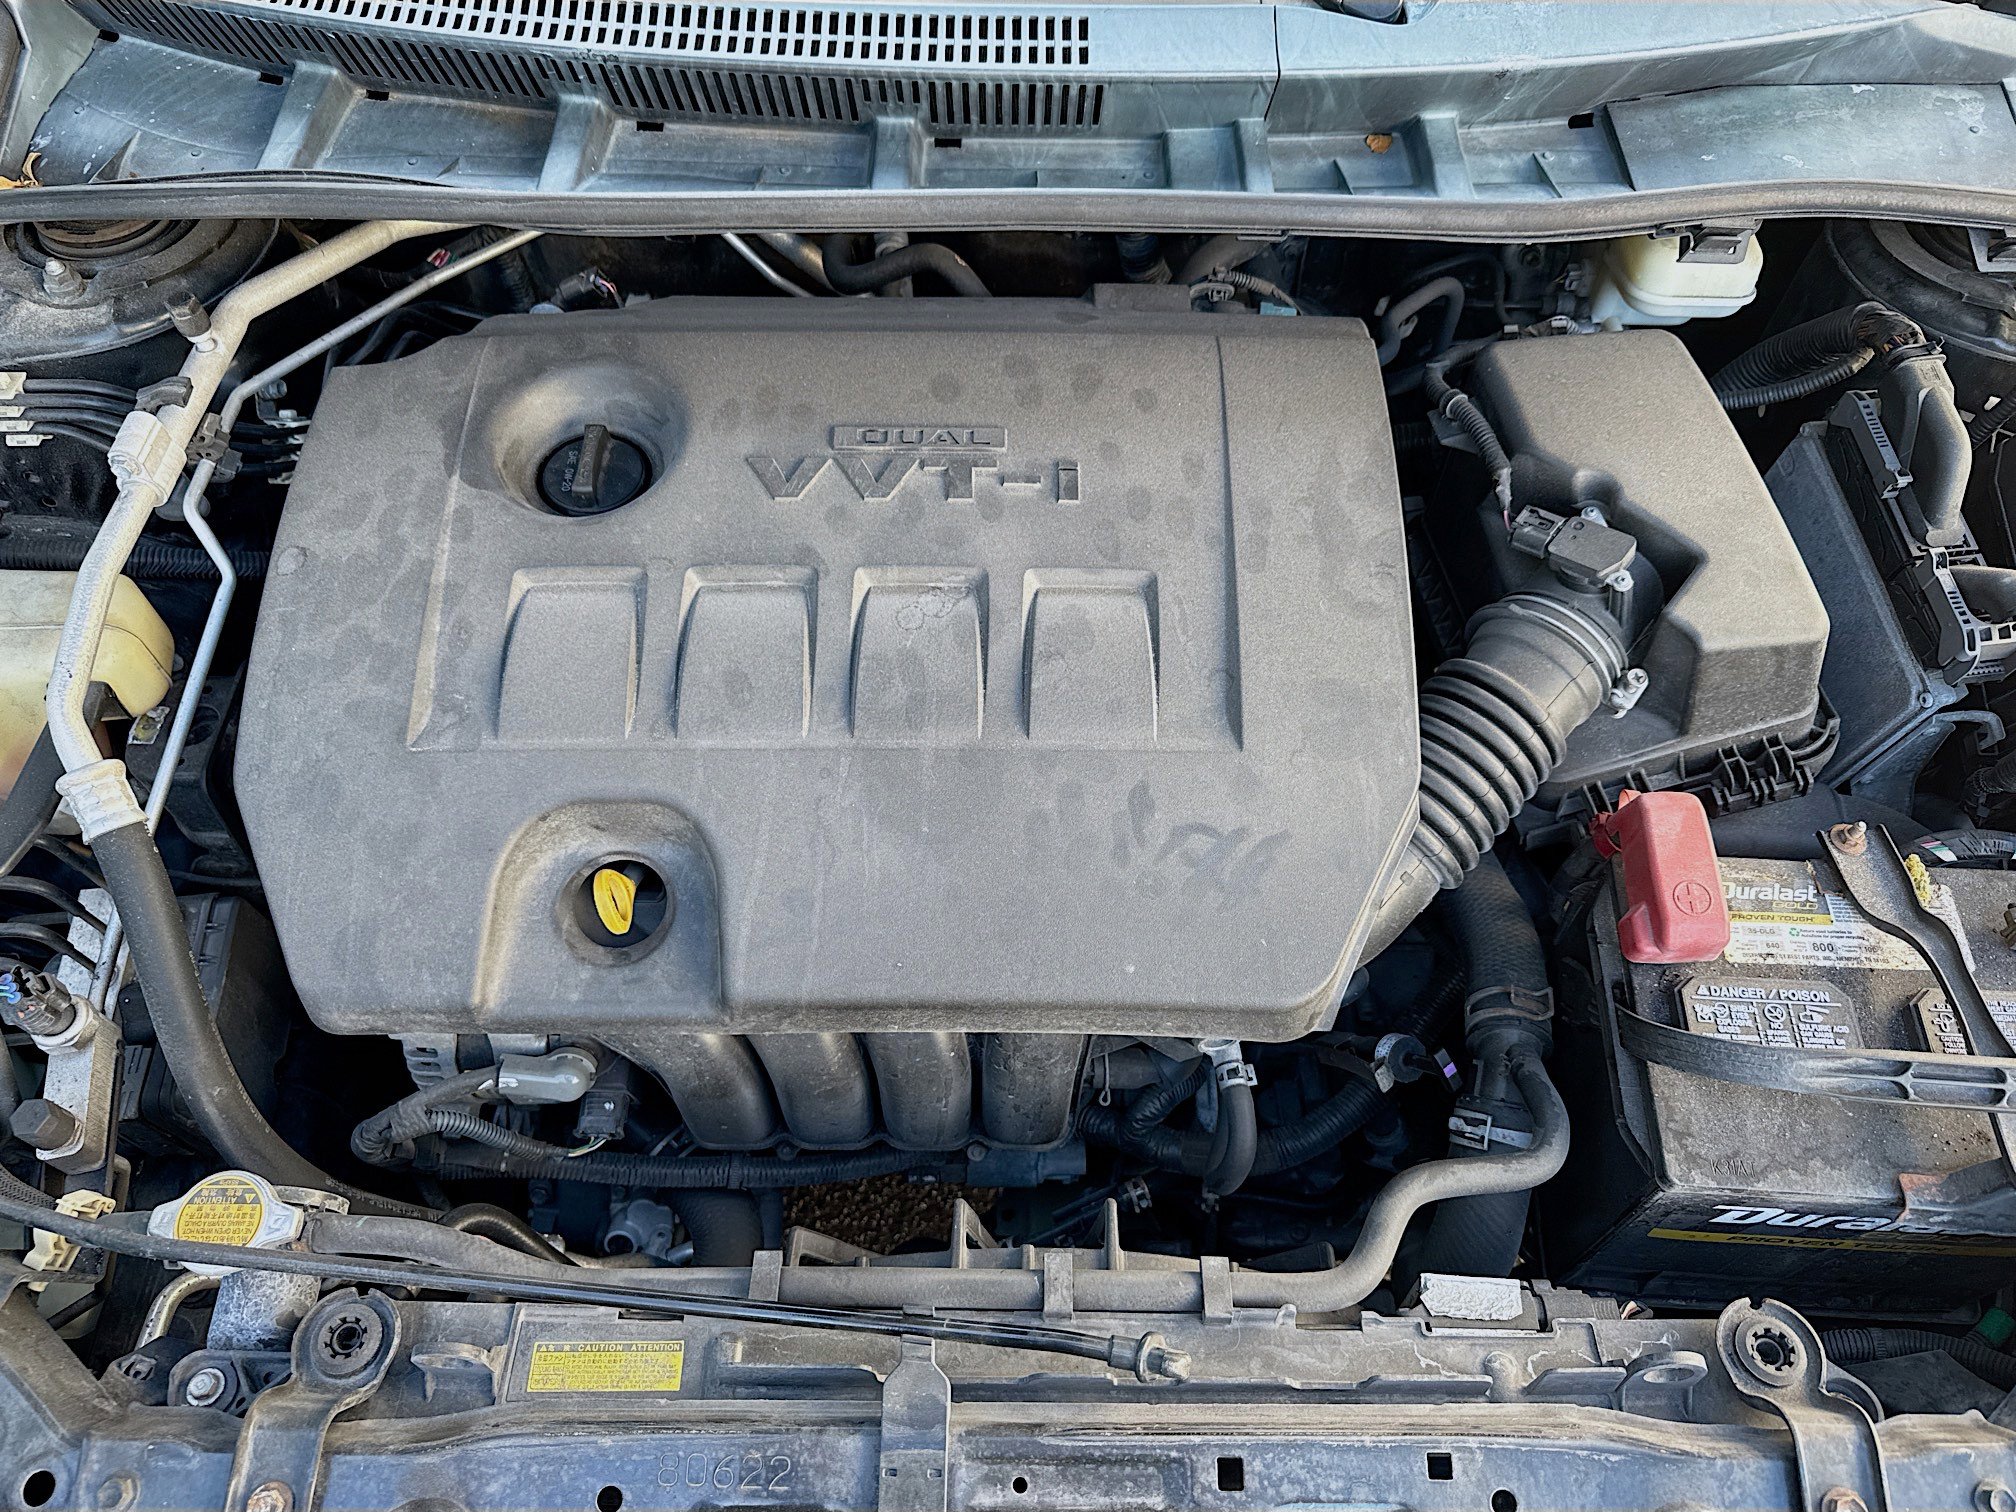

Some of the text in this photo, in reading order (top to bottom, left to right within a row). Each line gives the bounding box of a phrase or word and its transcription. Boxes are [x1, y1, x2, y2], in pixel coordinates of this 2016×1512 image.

[857, 429, 991, 445] DUAL
[561, 450, 578, 492] SAE 0W-20
[1772, 901, 1818, 911] GOLD
[1731, 913, 1814, 922] PROVEN TOUGH
[1812, 942, 1834, 952] 800
[1709, 985, 1831, 1002] DANGER / POISON
[1730, 1004, 1755, 1012] SHIELD
[1731, 1011, 1749, 1019] EYES
[1716, 1018, 1753, 1027] EXPLOSIVE
[1718, 1025, 1740, 1033] GASES
[1799, 1023, 1849, 1034] SULFURIC ACID
[193, 1196, 238, 1204] ATTENTION
[196, 1227, 214, 1235] WHEN
[215, 1227, 232, 1235] OPEN
[232, 1227, 252, 1235] NEVER
[1726, 1236, 1844, 1247] PROVEN
[577, 1344, 623, 1352] CAUTION
[631, 1343, 680, 1351] ATTENTION
[657, 1452, 791, 1490] 80622
